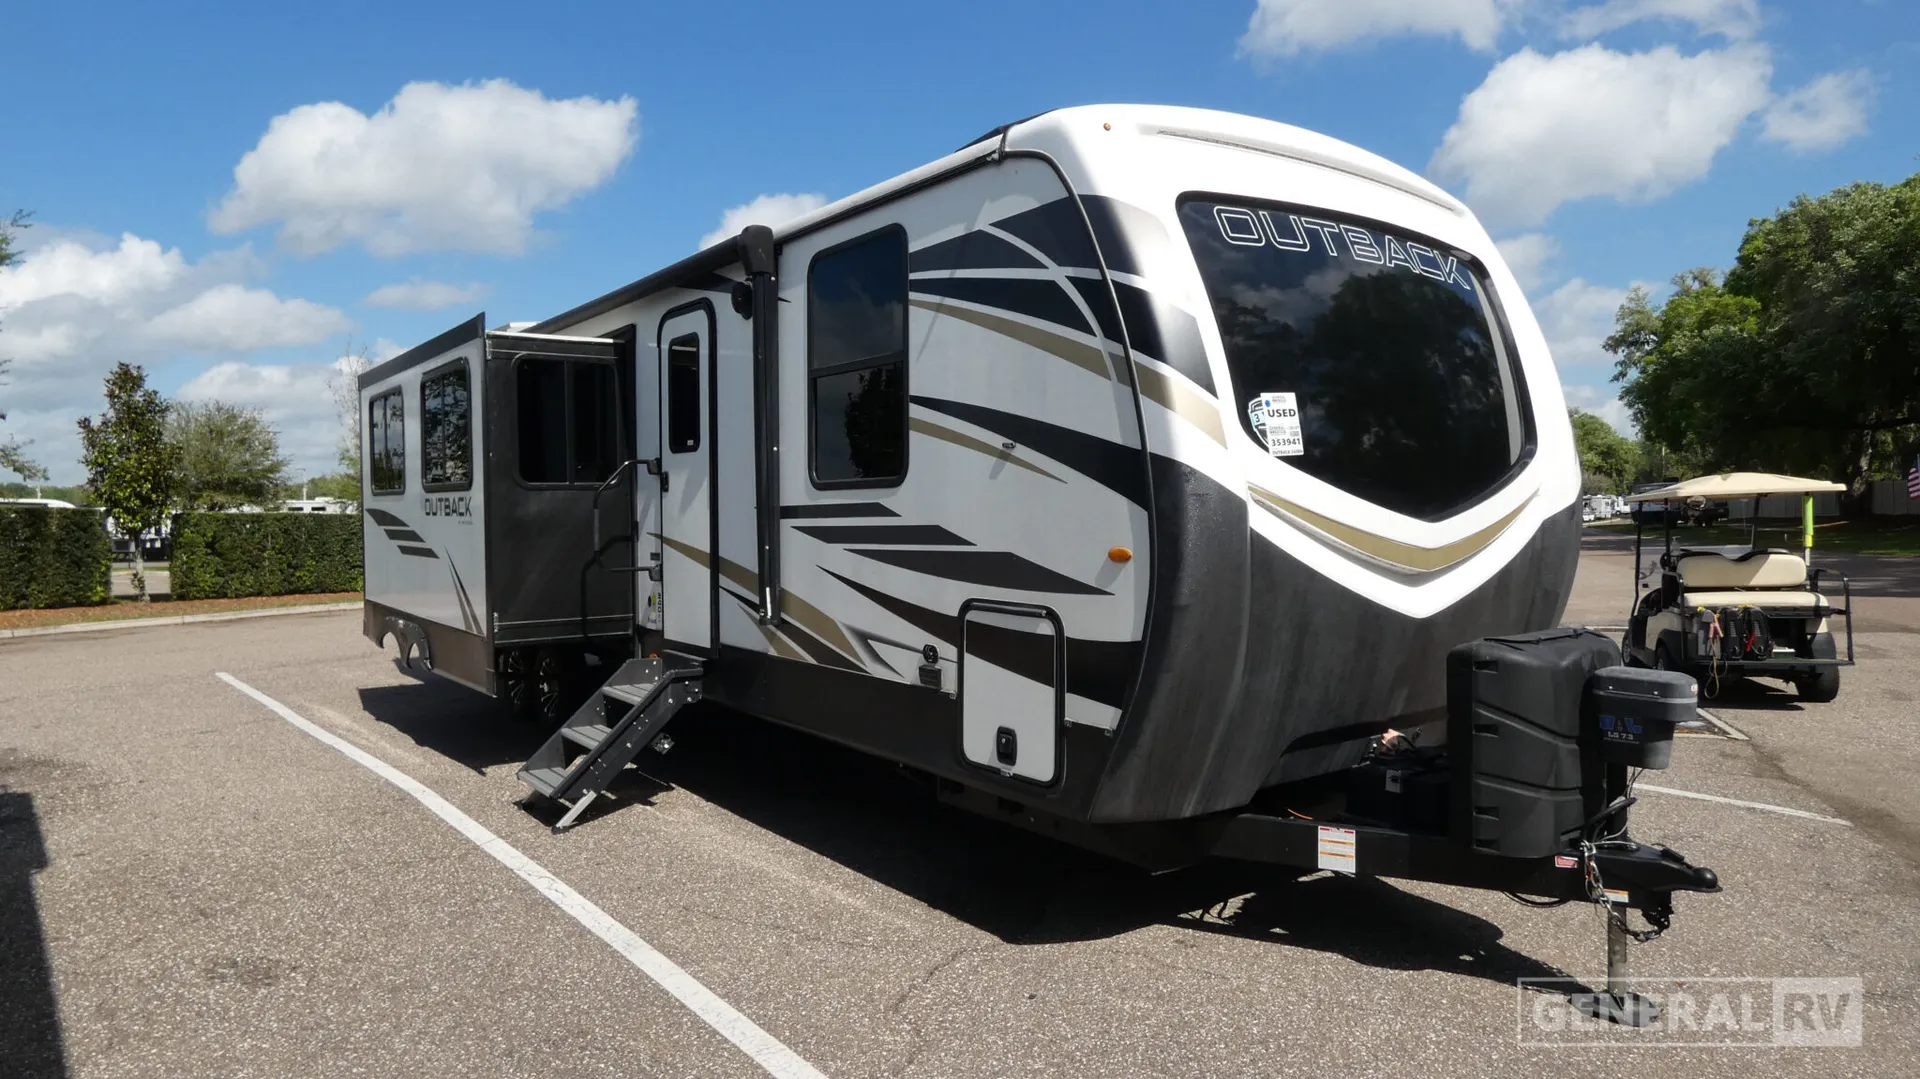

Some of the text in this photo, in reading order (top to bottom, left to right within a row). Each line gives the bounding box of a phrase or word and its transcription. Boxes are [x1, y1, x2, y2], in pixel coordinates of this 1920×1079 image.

[1213, 205, 1472, 291] OUTBACK
[1267, 409, 1296, 418] USED
[1271, 438, 1301, 446] 353941
[424, 496, 472, 517] OUTBACK
